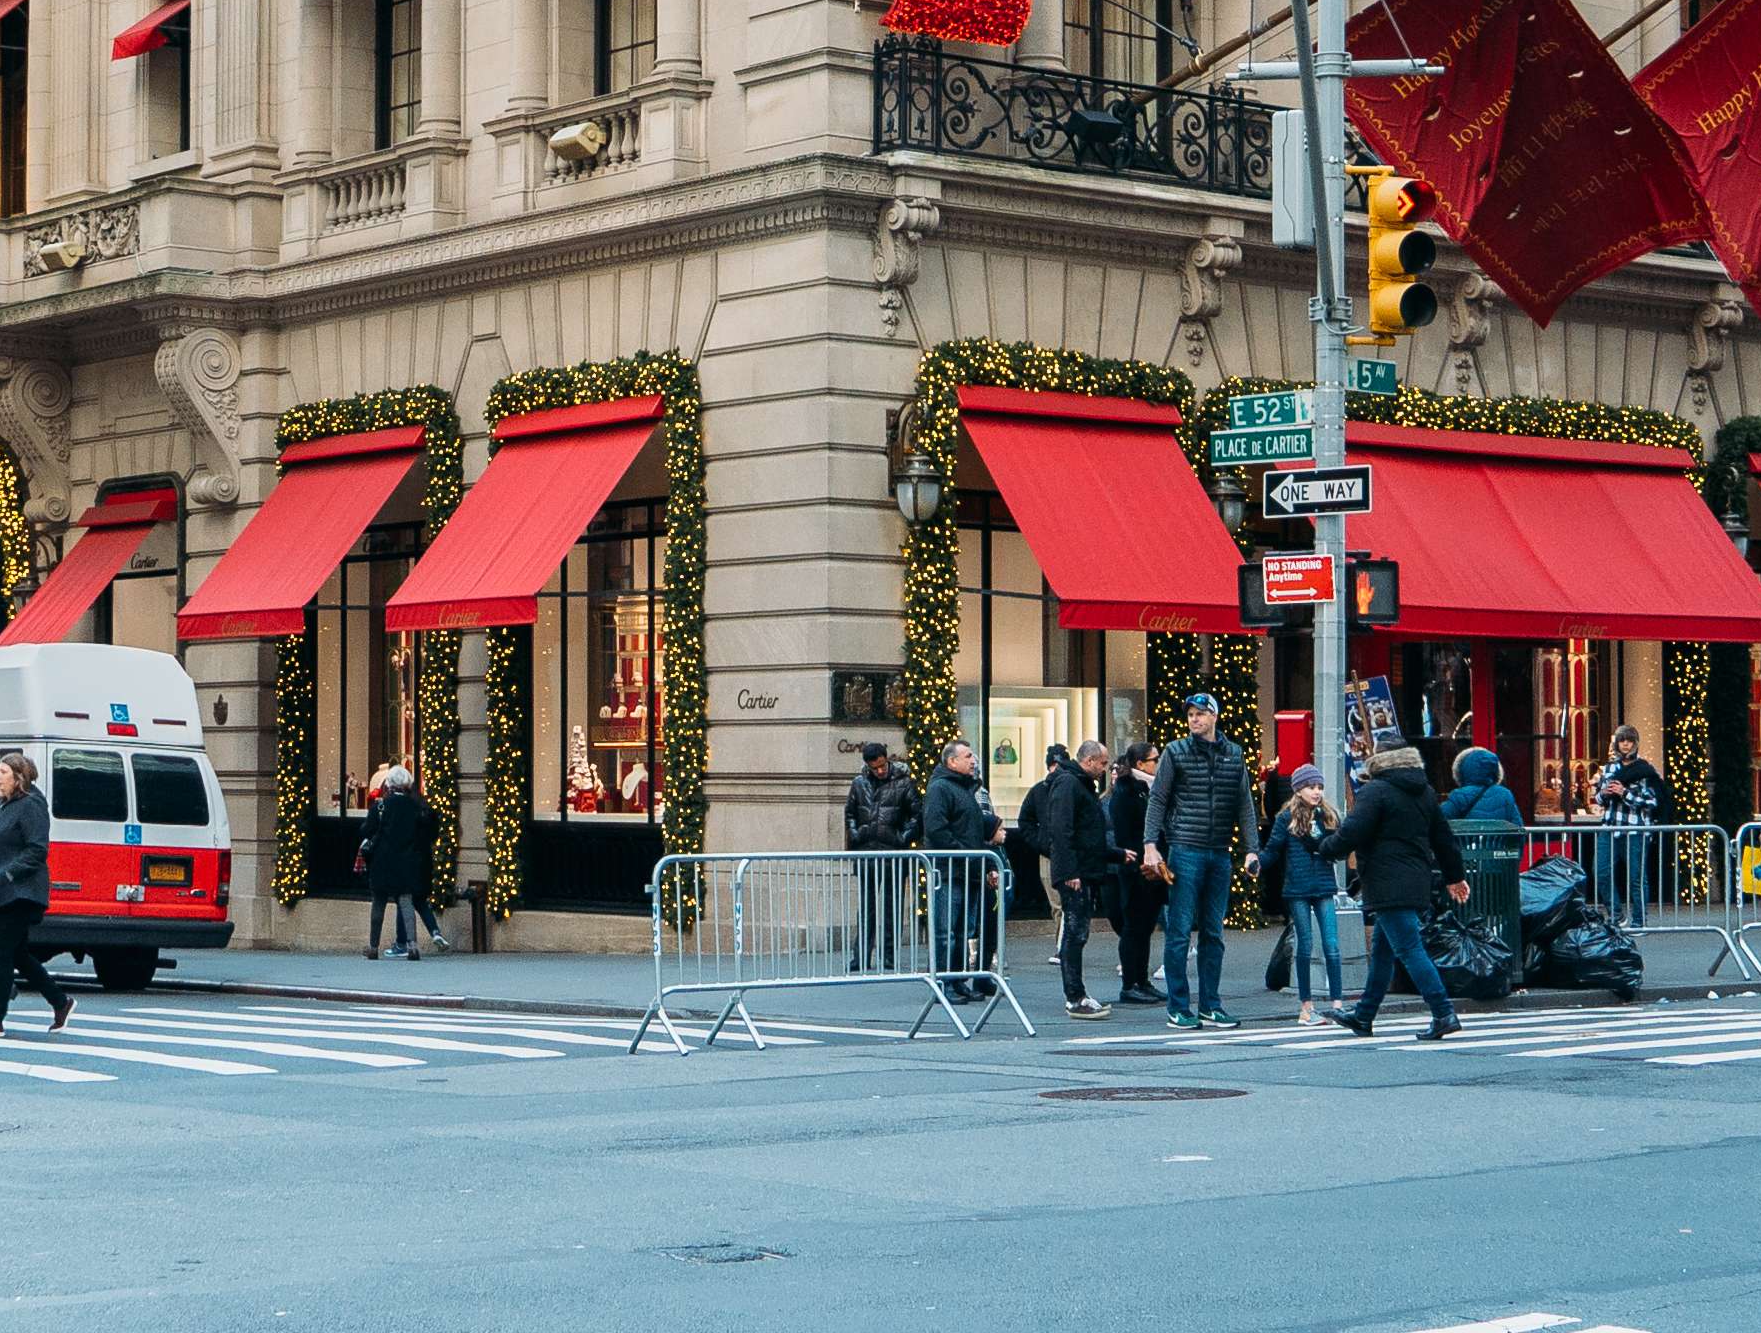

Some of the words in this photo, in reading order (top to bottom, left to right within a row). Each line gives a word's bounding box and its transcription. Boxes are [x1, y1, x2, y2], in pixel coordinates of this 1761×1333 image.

[1697, 84, 1755, 135] Happy
[1362, 364, 1372, 388] 5
[1375, 365, 1386, 377] AV
[1233, 401, 1247, 426] E
[1254, 397, 1282, 424] 52
[1283, 396, 1296, 410] ST
[1215, 437, 1247, 458] PLACE
[1265, 434, 1307, 455] CARTIER
[1280, 484, 1310, 502] ONE
[1324, 481, 1356, 500] WAY
[130, 553, 159, 569] Cartier
[1268, 561, 1280, 572] NO
[1281, 559, 1323, 571] STANDING
[1269, 571, 1303, 583] Anytime
[438, 603, 481, 626] Cartier
[1138, 605, 1197, 630] Cartier
[1558, 616, 1607, 637] Cartier
[737, 688, 779, 710] Cartier
